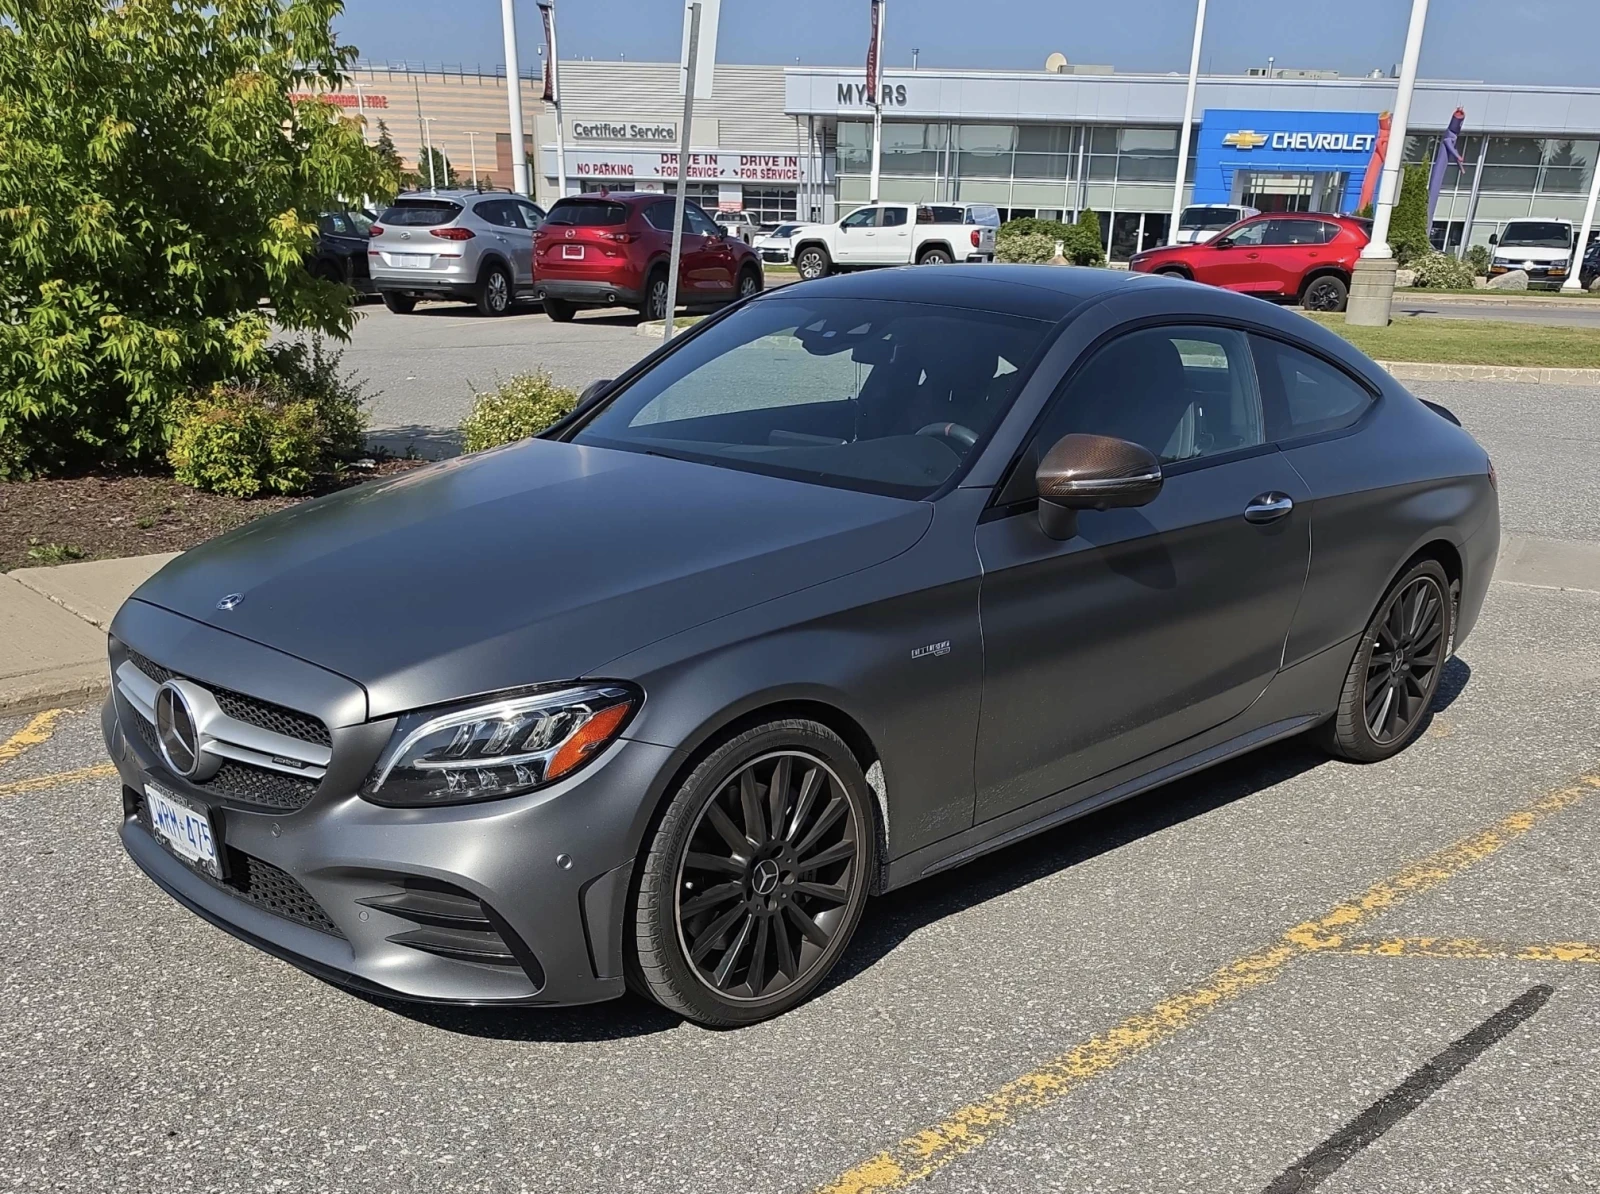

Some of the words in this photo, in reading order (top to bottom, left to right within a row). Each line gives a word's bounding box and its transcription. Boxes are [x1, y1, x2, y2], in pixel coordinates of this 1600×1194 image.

[837, 83, 907, 106] MYRS
[574, 123, 626, 137] Certified
[630, 125, 674, 139] Service
[1272, 132, 1375, 151] CHEVROLET
[661, 153, 700, 165] DRE
[704, 154, 718, 165] IN
[740, 155, 780, 167] DRIVE
[784, 156, 797, 168] IN
[577, 163, 590, 174] NO
[593, 164, 634, 175] PARKING
[661, 166, 678, 177] FOR
[682, 166, 718, 178] ERVICE
[740, 168, 758, 179] FOR
[760, 168, 797, 180] SERVICE
